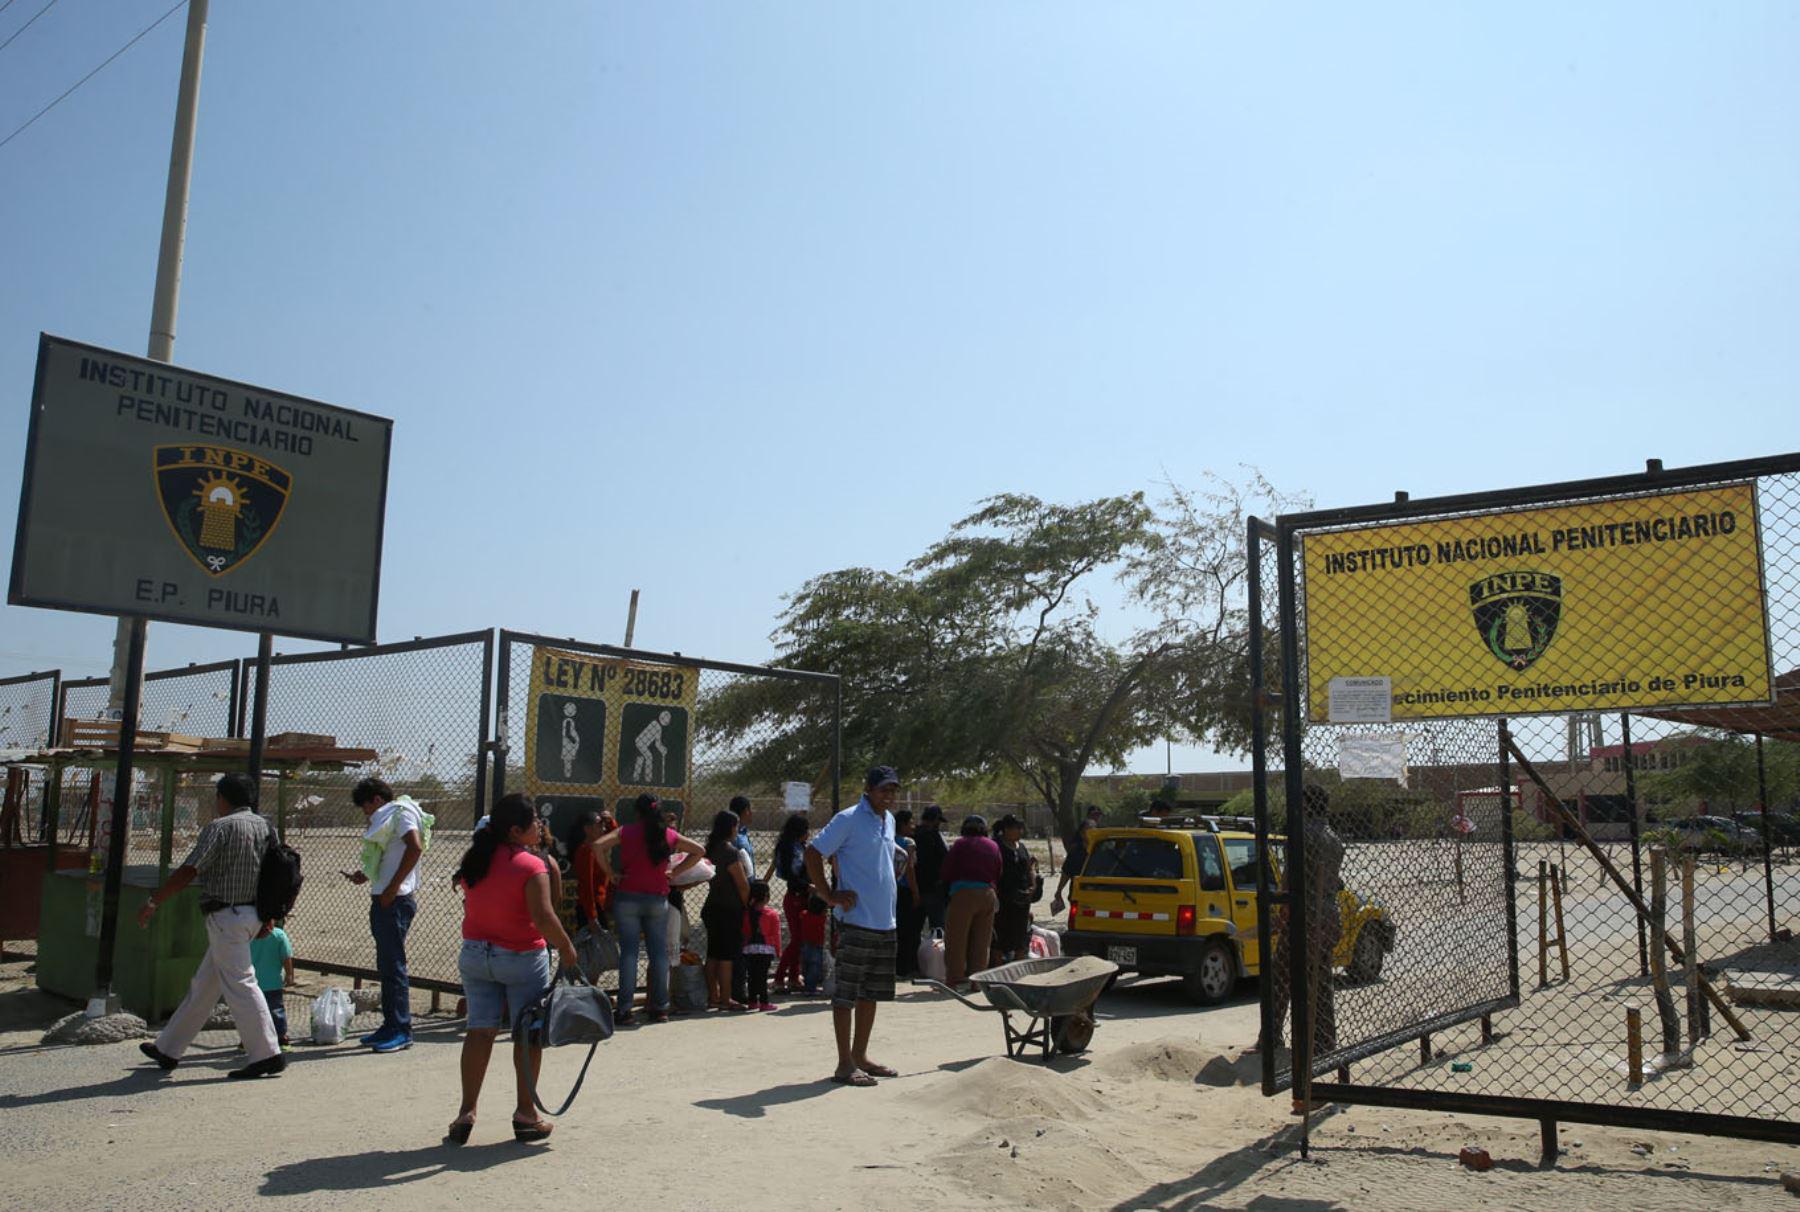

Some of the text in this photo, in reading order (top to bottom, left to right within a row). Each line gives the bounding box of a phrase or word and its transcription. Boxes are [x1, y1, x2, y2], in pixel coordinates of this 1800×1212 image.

[79, 358, 358, 442] INSTITUTO NACIONAL
[117, 394, 312, 456] PENITENCIARIO
[178, 447, 271, 480] INPE
[1325, 511, 1736, 574] INSTITUTO NACIONAL PENITENCIARIO
[135, 579, 280, 618] E.P. PIURA
[1477, 571, 1555, 598] INPE
[543, 655, 584, 689] LEY
[623, 667, 684, 699] 28683
[1497, 679, 1641, 700] Penitenciario
[1648, 676, 1676, 692] de
[1684, 673, 1745, 690] Piura
